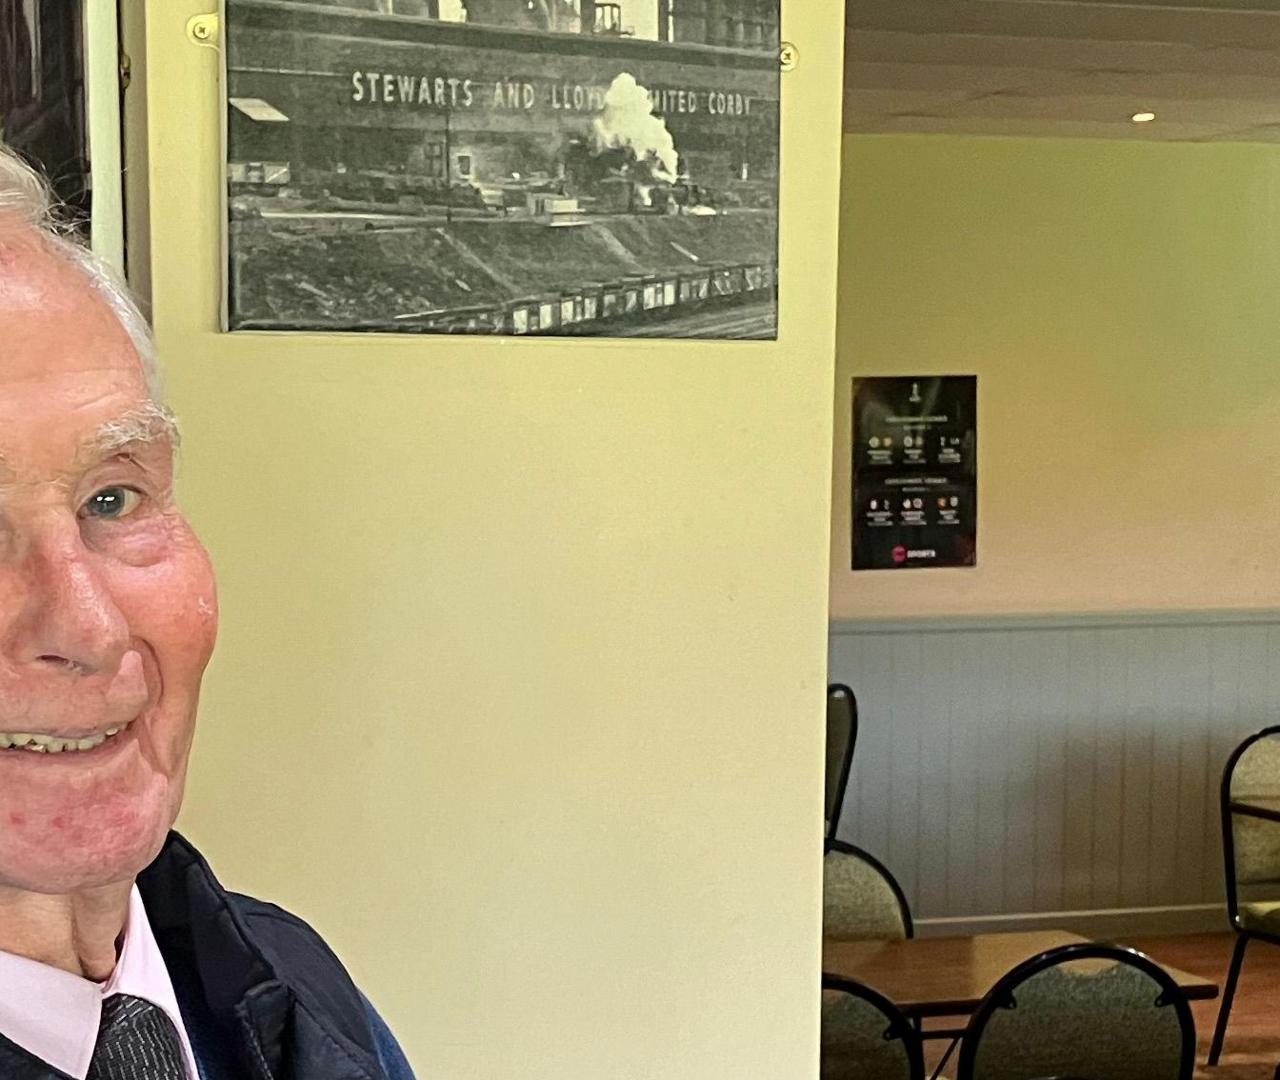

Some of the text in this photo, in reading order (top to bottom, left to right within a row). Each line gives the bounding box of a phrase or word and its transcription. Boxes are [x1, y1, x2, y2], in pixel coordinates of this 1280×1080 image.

[352, 71, 473, 107] STEWARTS
[494, 81, 535, 110] AND
[707, 92, 751, 116] CORBY
